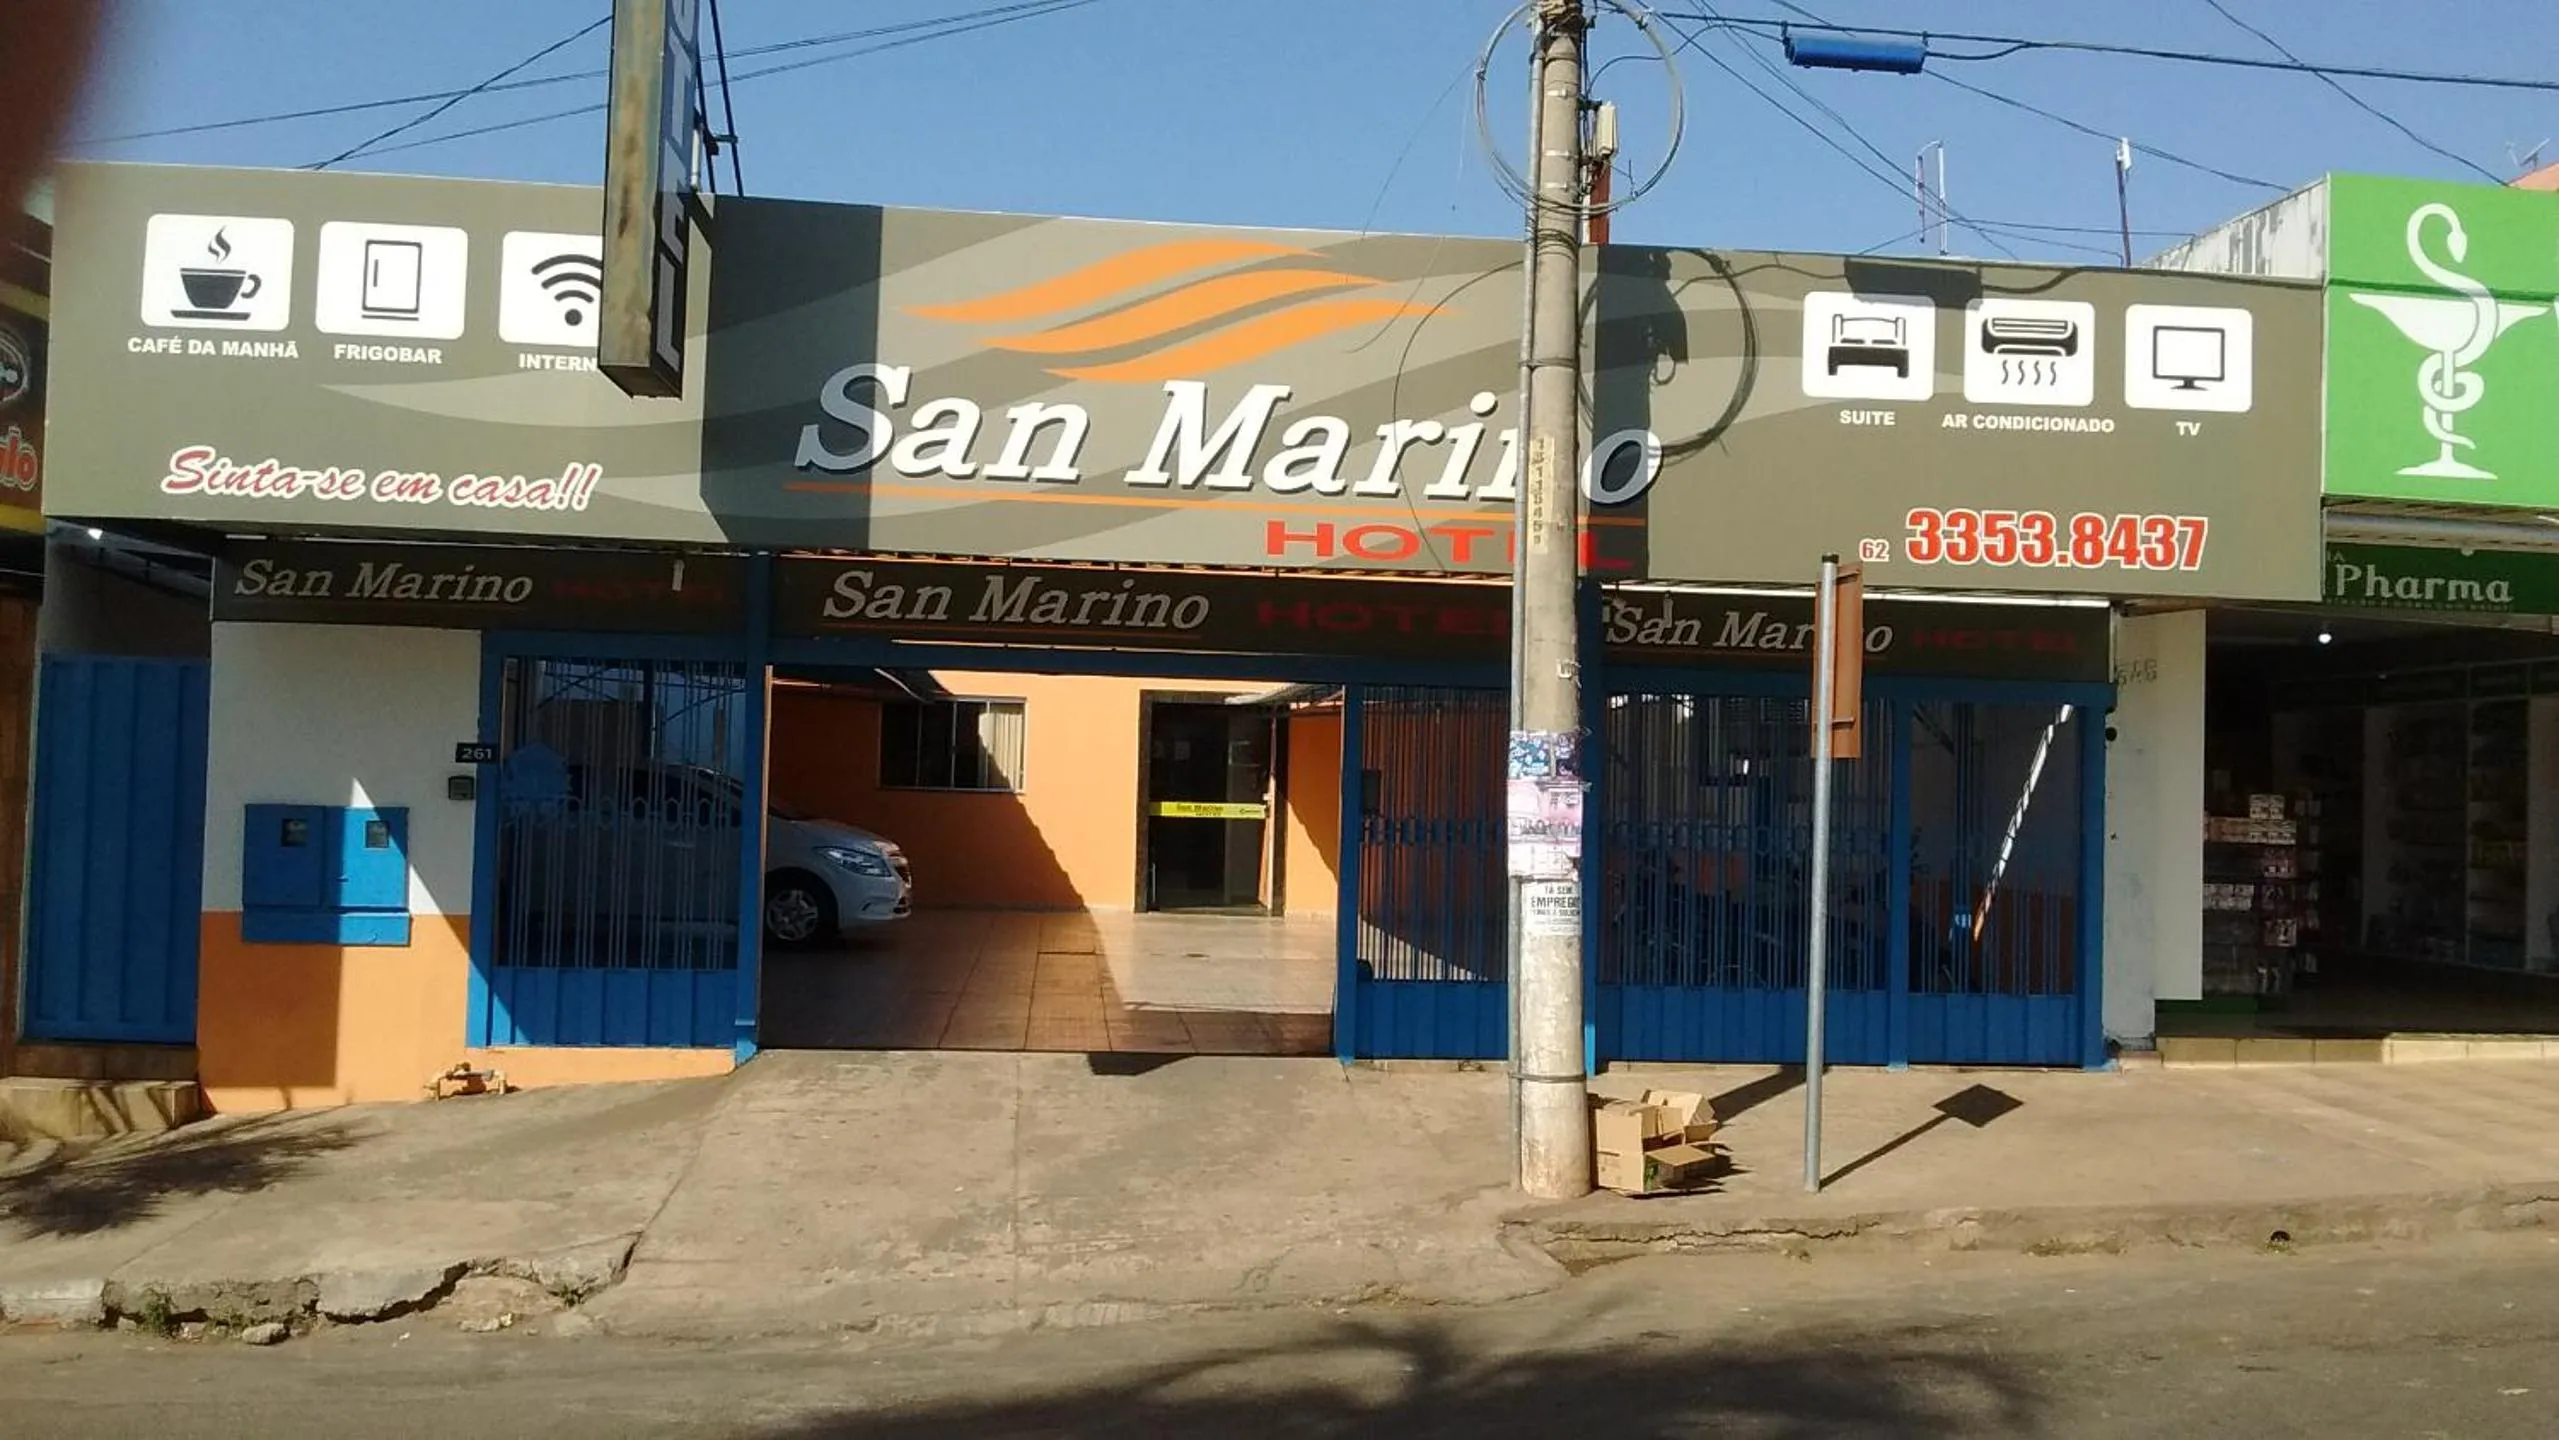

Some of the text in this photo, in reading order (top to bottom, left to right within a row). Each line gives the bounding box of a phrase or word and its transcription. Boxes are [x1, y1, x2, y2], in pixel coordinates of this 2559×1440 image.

[127, 336, 299, 360] CAFÉ DA MANHÃ
[333, 343, 443, 365] FRIGOBAR
[518, 352, 599, 374] INTERN
[794, 363, 1091, 482] San
[1839, 409, 1896, 427] SUITE
[1941, 412, 2116, 434] AR CONDICIONADO
[2175, 421, 2202, 437] TV
[160, 444, 602, 511] Sinta-se em casa!!
[1266, 521, 1633, 569] HOTL
[1859, 507, 2209, 573] 62 3353.8437
[235, 558, 331, 598] San
[344, 563, 534, 603] Marino
[2337, 564, 2513, 602] Pharma
[822, 570, 951, 622] San
[970, 575, 1210, 630] Marino
[1605, 606, 1700, 648] San
[1712, 611, 1895, 655] Maro
[461, 747, 493, 761] 261
